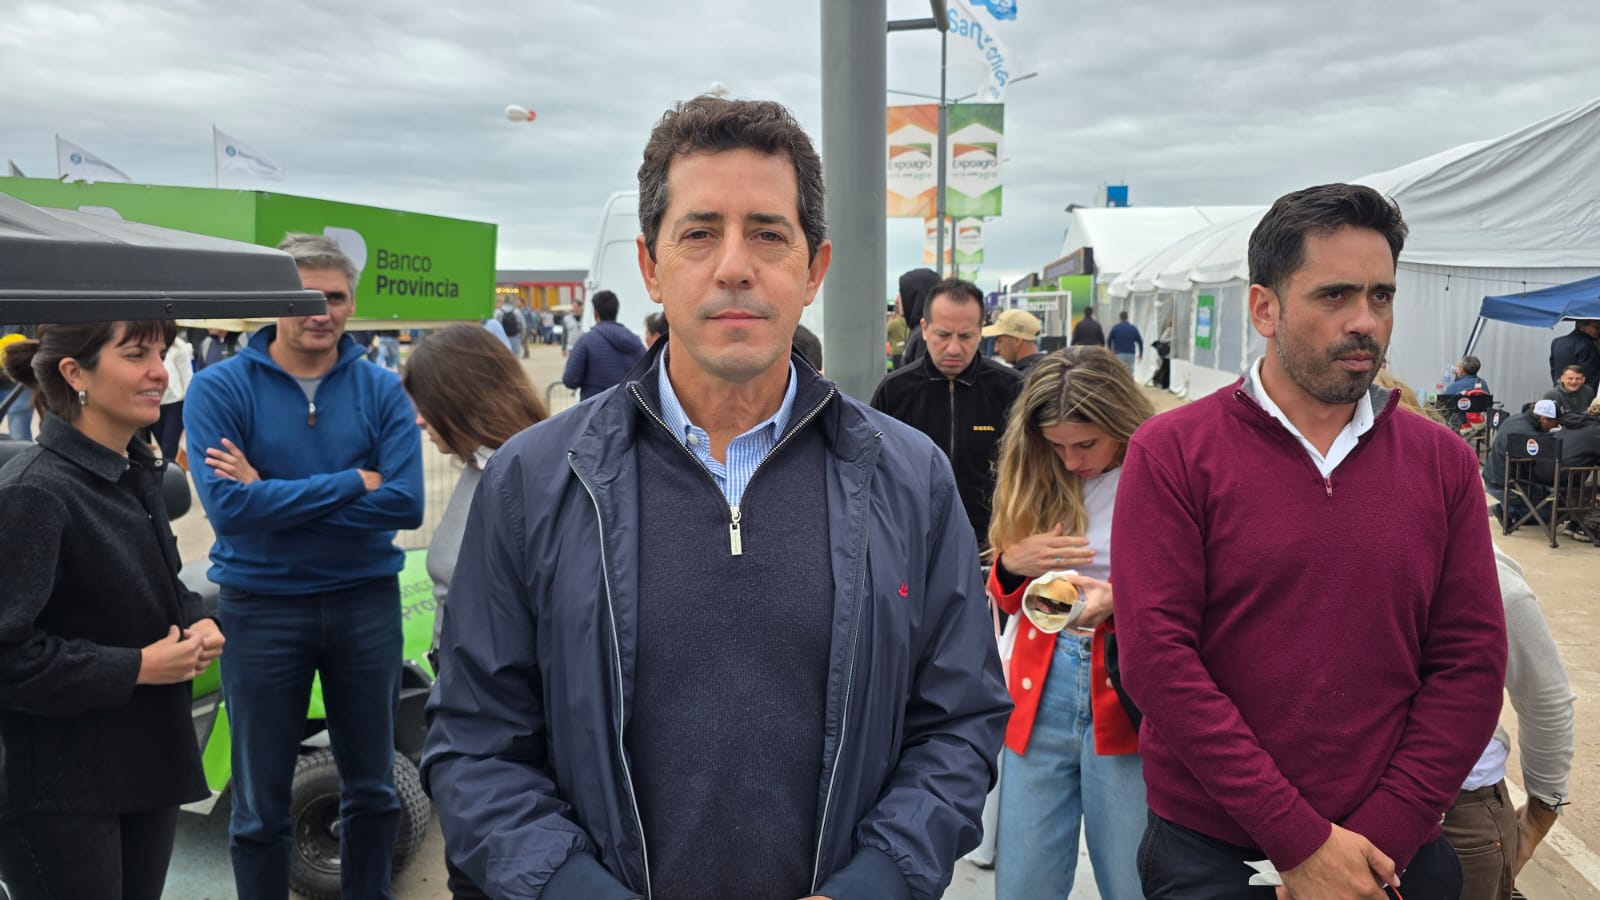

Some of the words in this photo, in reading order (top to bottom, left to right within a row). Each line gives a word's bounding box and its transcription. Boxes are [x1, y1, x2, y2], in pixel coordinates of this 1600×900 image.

[888, 159, 932, 171] Expoagro
[952, 159, 997, 171] Expoagro
[377, 249, 432, 272] Banco
[377, 275, 459, 298] Provincia
